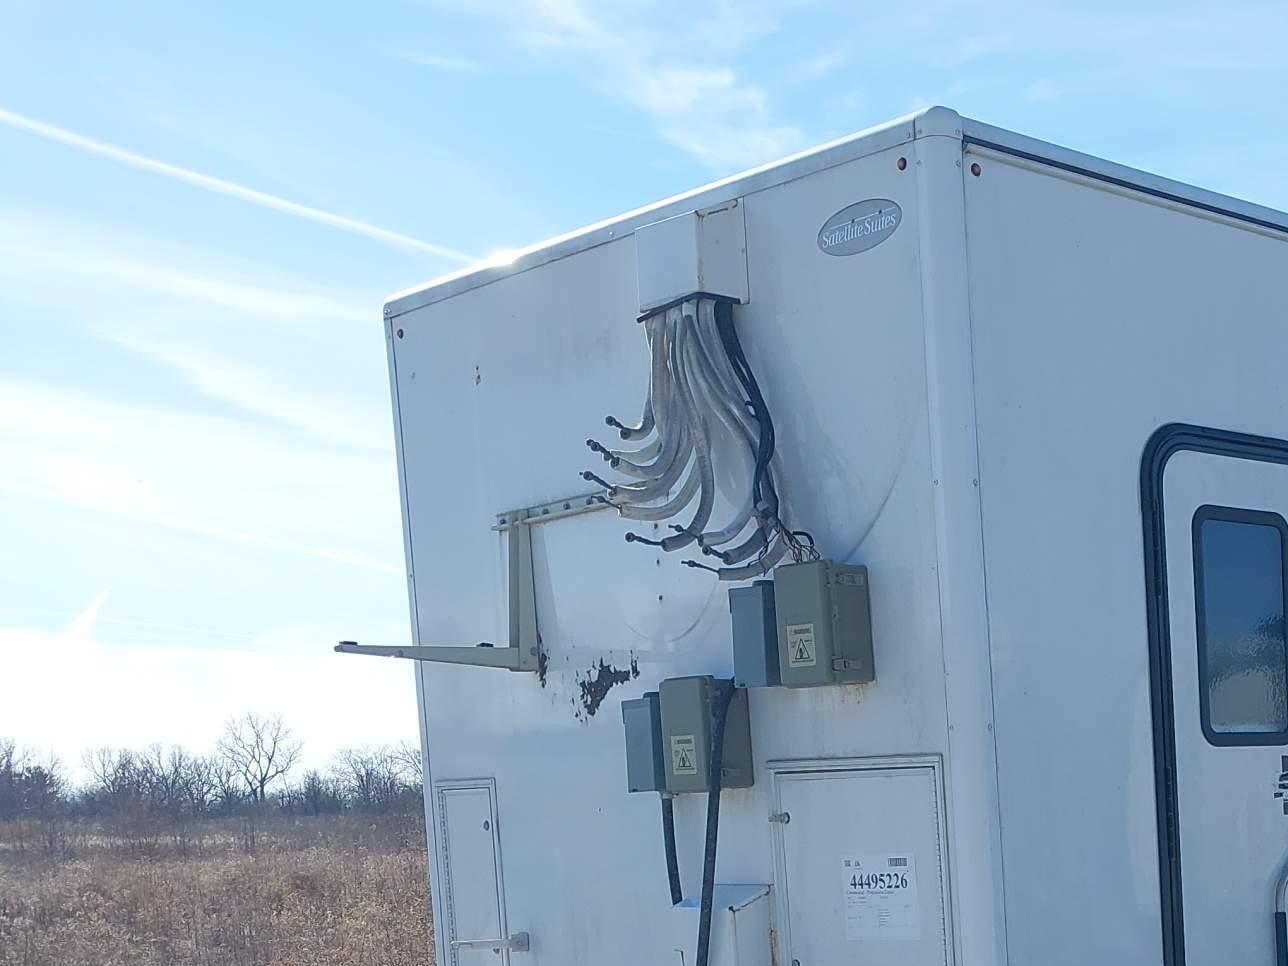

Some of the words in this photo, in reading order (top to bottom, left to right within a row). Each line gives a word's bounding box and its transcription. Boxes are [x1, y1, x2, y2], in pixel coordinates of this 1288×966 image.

[822, 223, 863, 250] Satellite
[863, 214, 896, 236] Suites
[850, 872, 908, 890] 44495226
